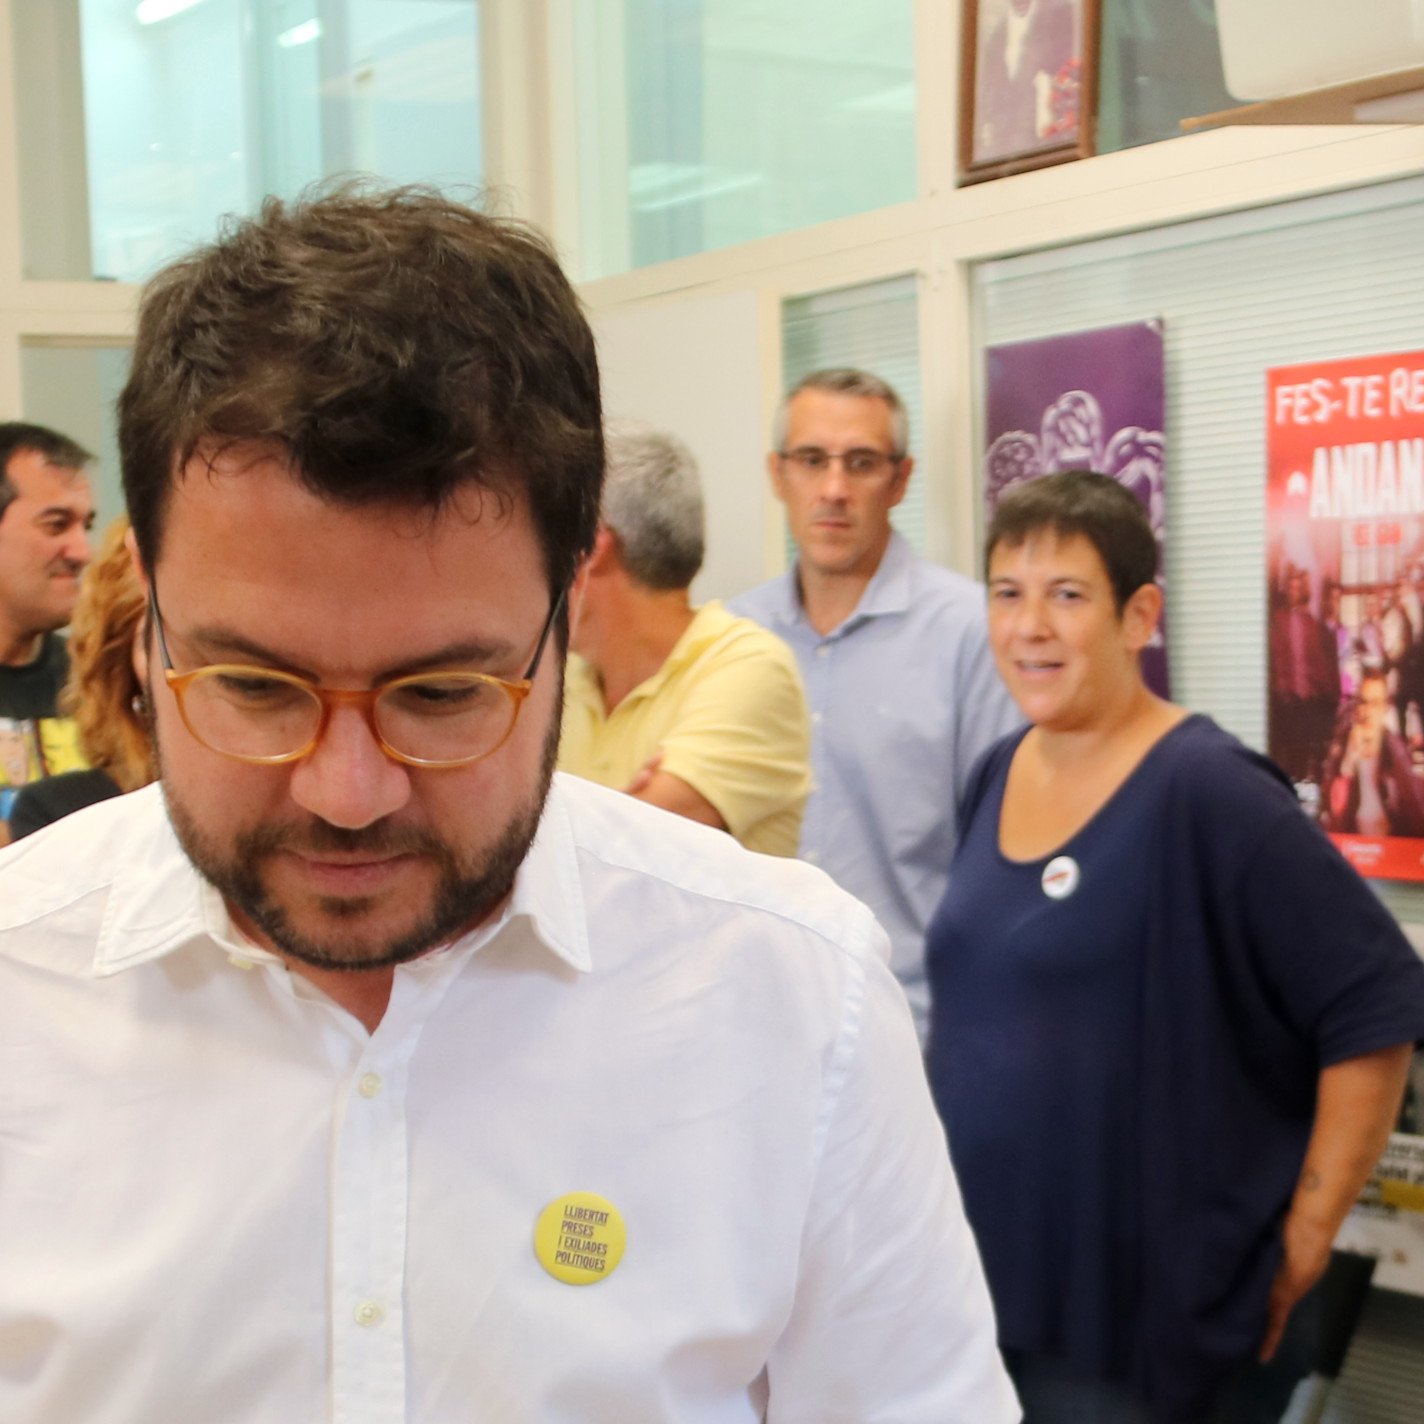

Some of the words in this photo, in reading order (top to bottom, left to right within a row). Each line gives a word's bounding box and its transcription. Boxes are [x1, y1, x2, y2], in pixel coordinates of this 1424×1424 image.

[1275, 376, 1384, 425] FES-TE
[564, 1205, 610, 1225] LLIBERTAT
[561, 1220, 595, 1238] PRESES
[557, 1235, 563, 1248] I
[564, 1236, 608, 1256] EXILIADES
[555, 1249, 607, 1272] POLÍTIQUES
